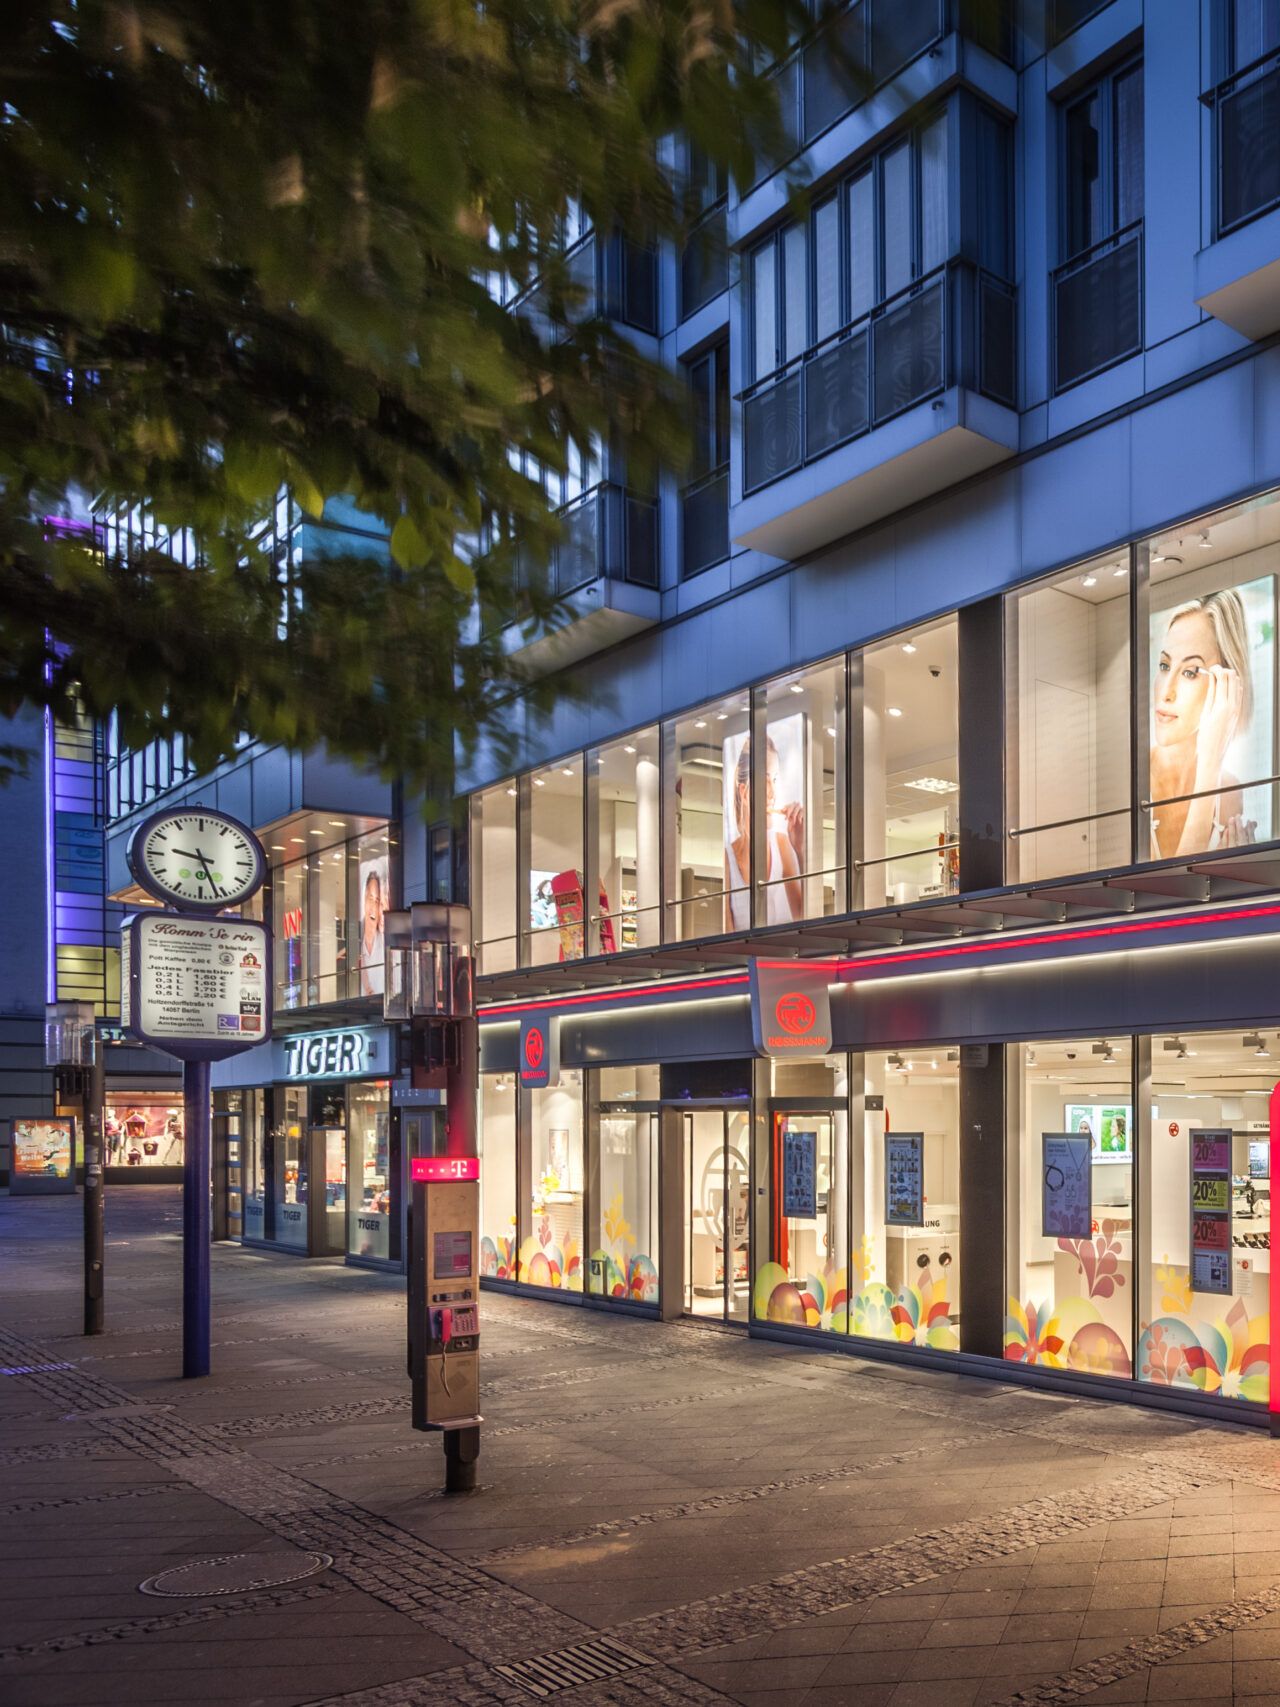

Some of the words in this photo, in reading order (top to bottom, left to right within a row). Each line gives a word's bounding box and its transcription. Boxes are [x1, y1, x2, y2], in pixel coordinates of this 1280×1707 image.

[152, 924, 206, 937] Komm
[233, 932, 255, 942] rin
[186, 967, 234, 975] Fassbier
[243, 1005, 257, 1013] sky
[768, 1036, 827, 1048] ROSSMANN
[284, 1033, 363, 1075] TIGER
[1194, 1144, 1216, 1161] 20%
[451, 1160, 467, 1178] T
[1193, 1182, 1217, 1200] 20%
[283, 1210, 301, 1221] TIGER
[358, 1218, 380, 1231] TIGER
[1194, 1222, 1216, 1241] 20%
